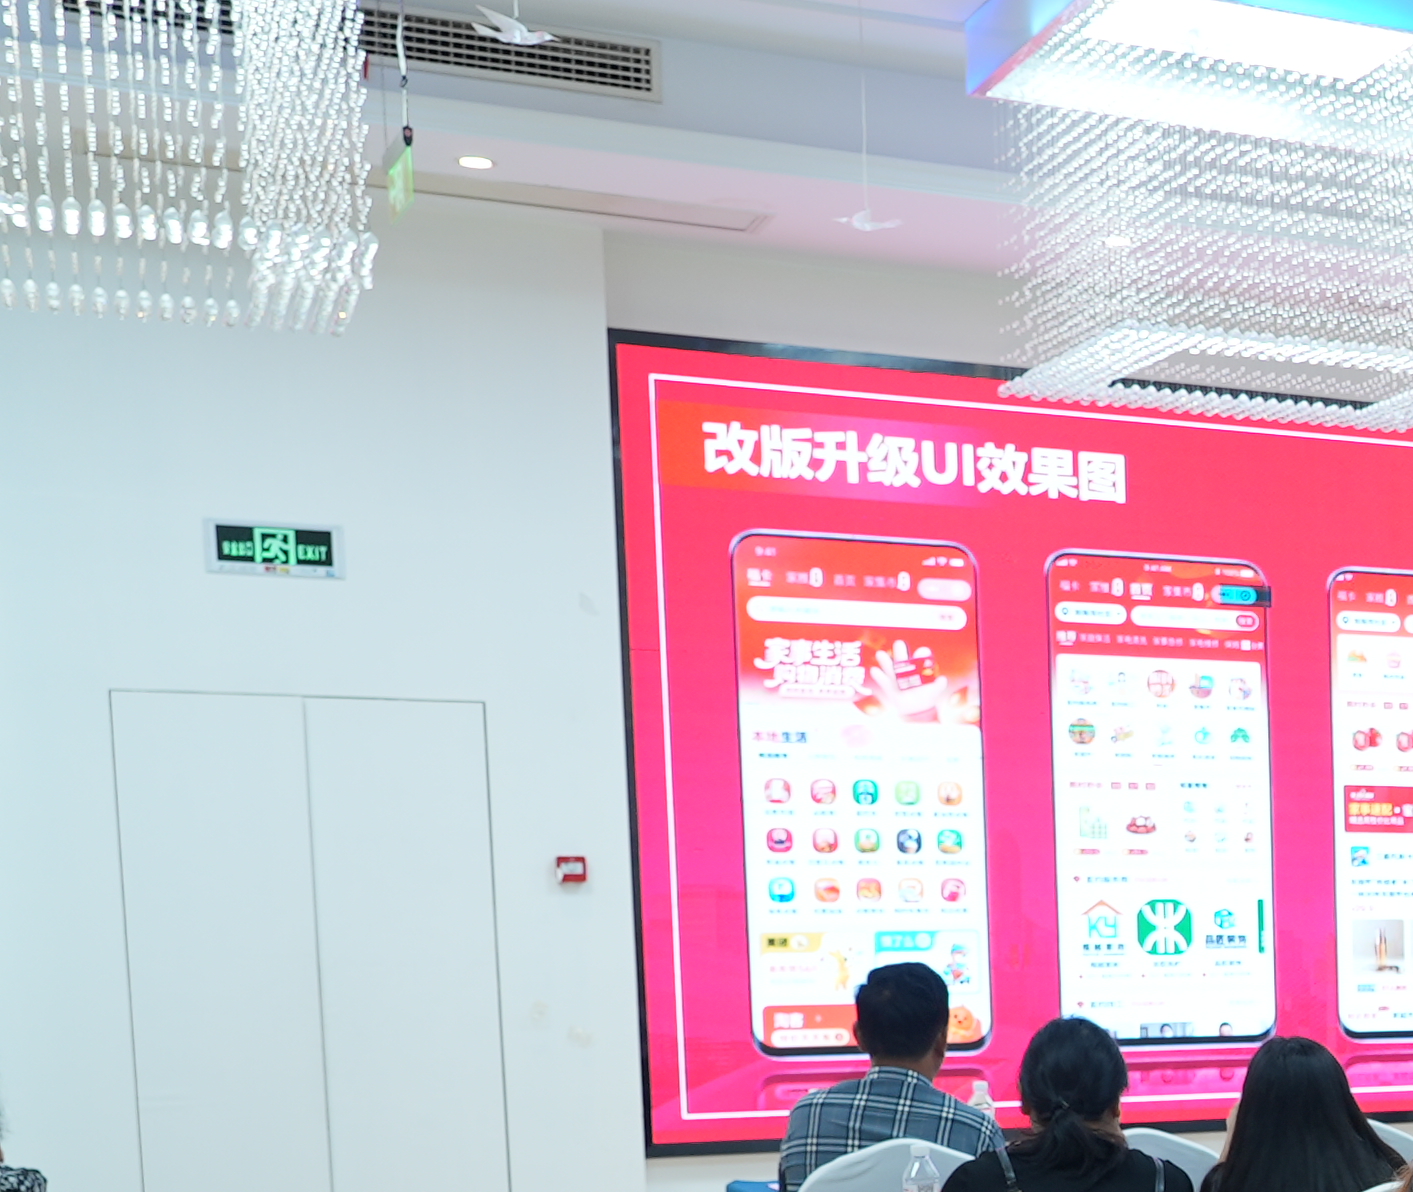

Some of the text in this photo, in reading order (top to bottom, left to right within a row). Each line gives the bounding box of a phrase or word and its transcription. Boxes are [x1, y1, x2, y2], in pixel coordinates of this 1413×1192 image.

[702, 421, 1127, 504] 改版升级UI效果图
[298, 544, 328, 561] EXIT
[754, 637, 862, 669] 家事生活
